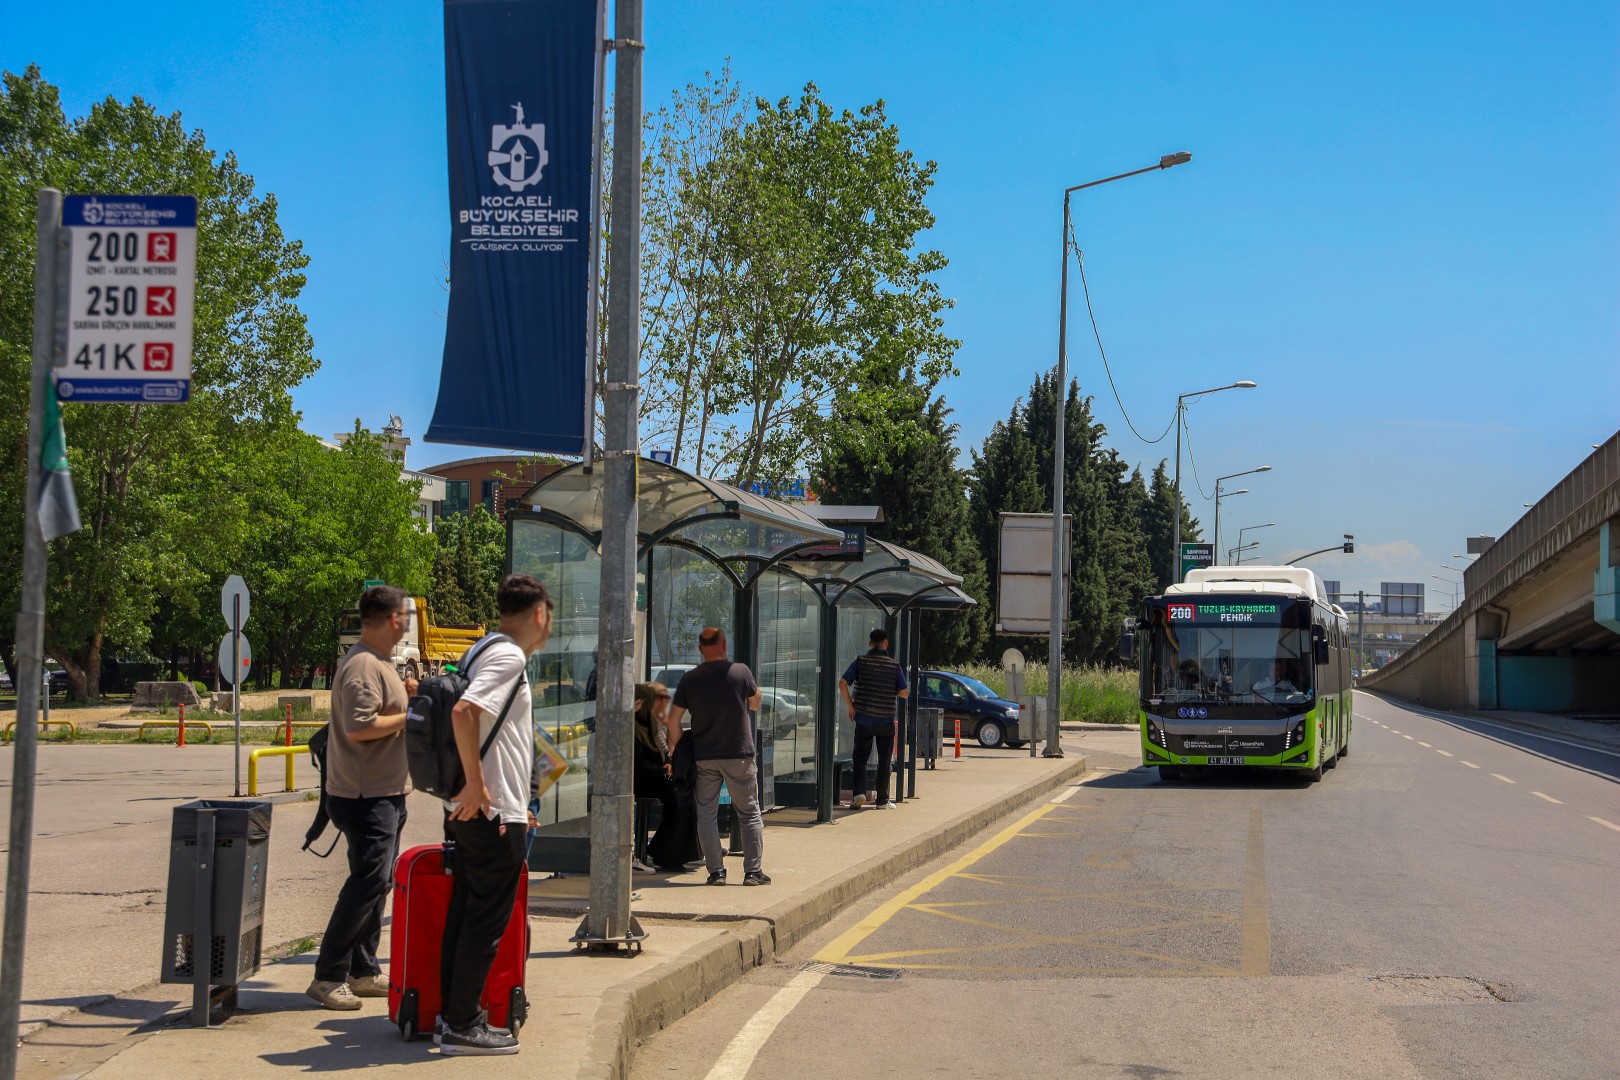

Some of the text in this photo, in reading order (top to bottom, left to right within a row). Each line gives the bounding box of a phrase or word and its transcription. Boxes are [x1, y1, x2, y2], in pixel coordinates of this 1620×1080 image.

[481, 196, 552, 207] KOCAELİ
[460, 209, 579, 224] BÜYÜKŞEHİR
[471, 225, 563, 236] BELEDİYESİ
[87, 232, 138, 262] 200
[522, 243, 564, 251] OLUYOR
[114, 267, 141, 276] KARTAL
[143, 267, 177, 276] METROSU
[86, 286, 138, 317] 250
[73, 320, 100, 331] SABİHA
[101, 320, 131, 332] GÖKÇEN
[74, 343, 137, 371] 41K
[1170, 607, 1192, 619] 200
